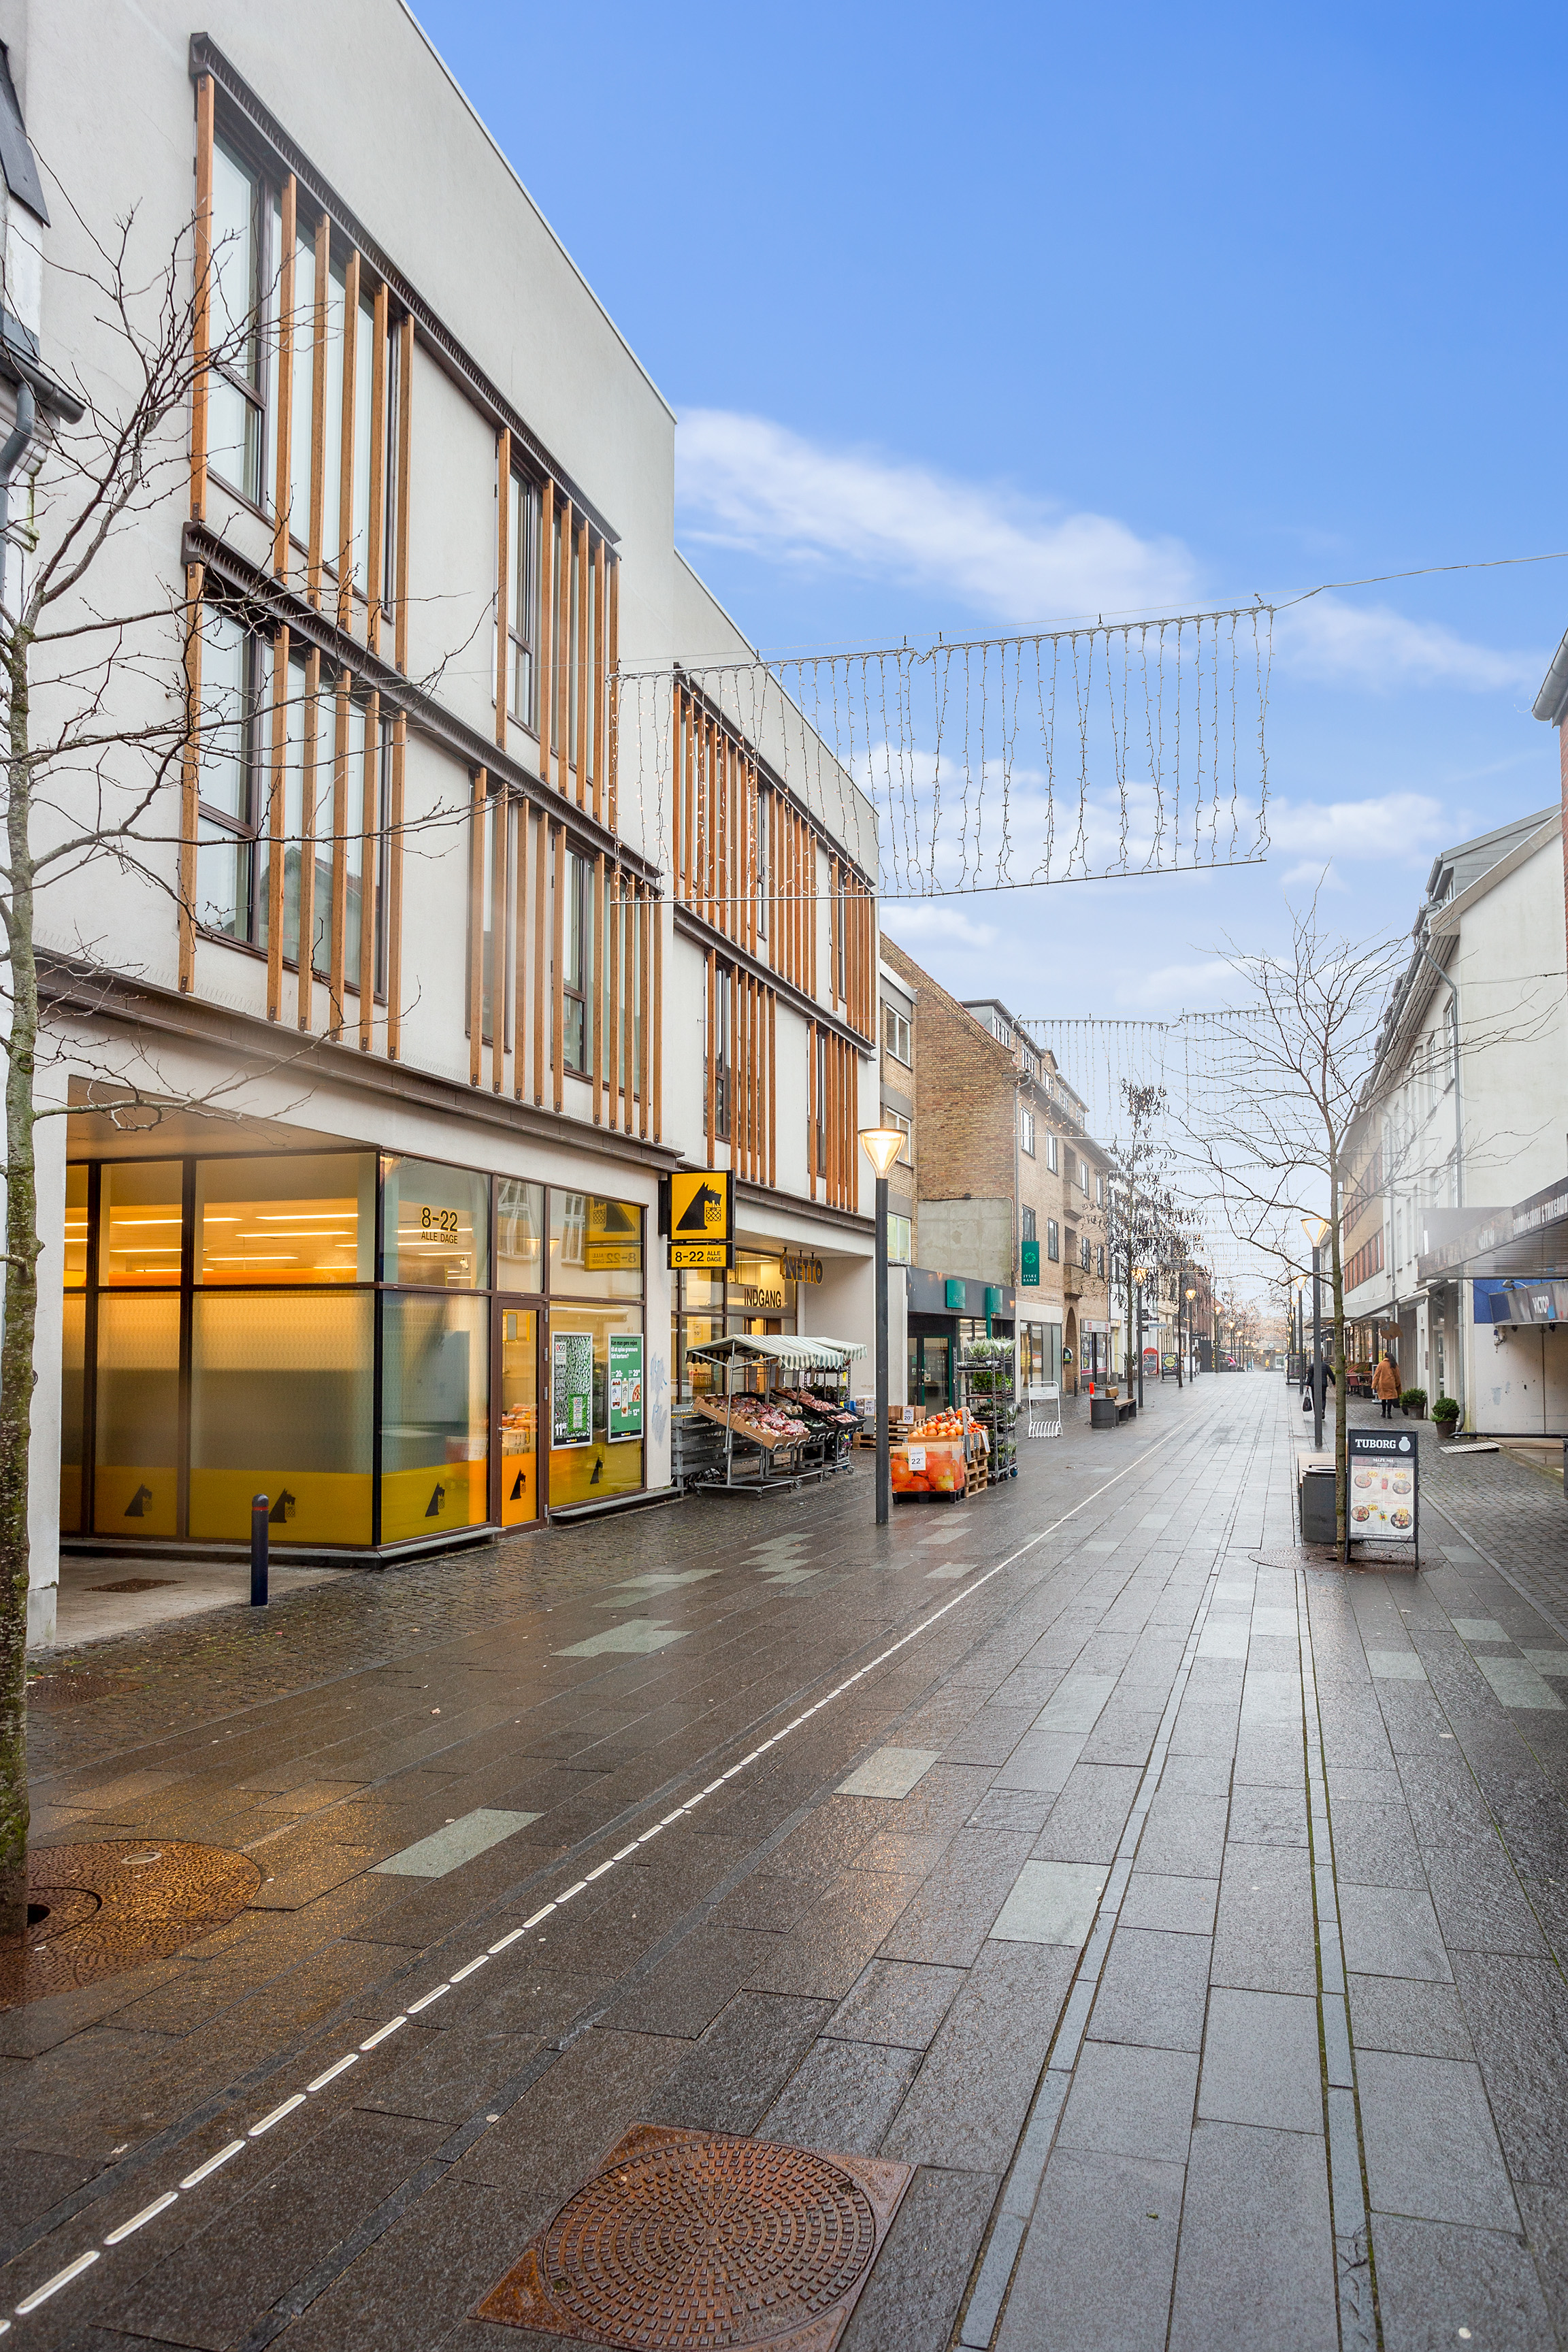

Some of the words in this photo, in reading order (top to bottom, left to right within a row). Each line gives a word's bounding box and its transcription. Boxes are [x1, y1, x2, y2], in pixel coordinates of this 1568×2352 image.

[421, 1206, 458, 1232] 8-22
[421, 1230, 438, 1241] ALLE
[440, 1232, 458, 1244] DAGE
[675, 1251, 704, 1262] 8-22
[783, 1255, 823, 1285] NETTO
[744, 1288, 781, 1309] INDGANG
[1355, 1439, 1396, 1449] TUBORG
